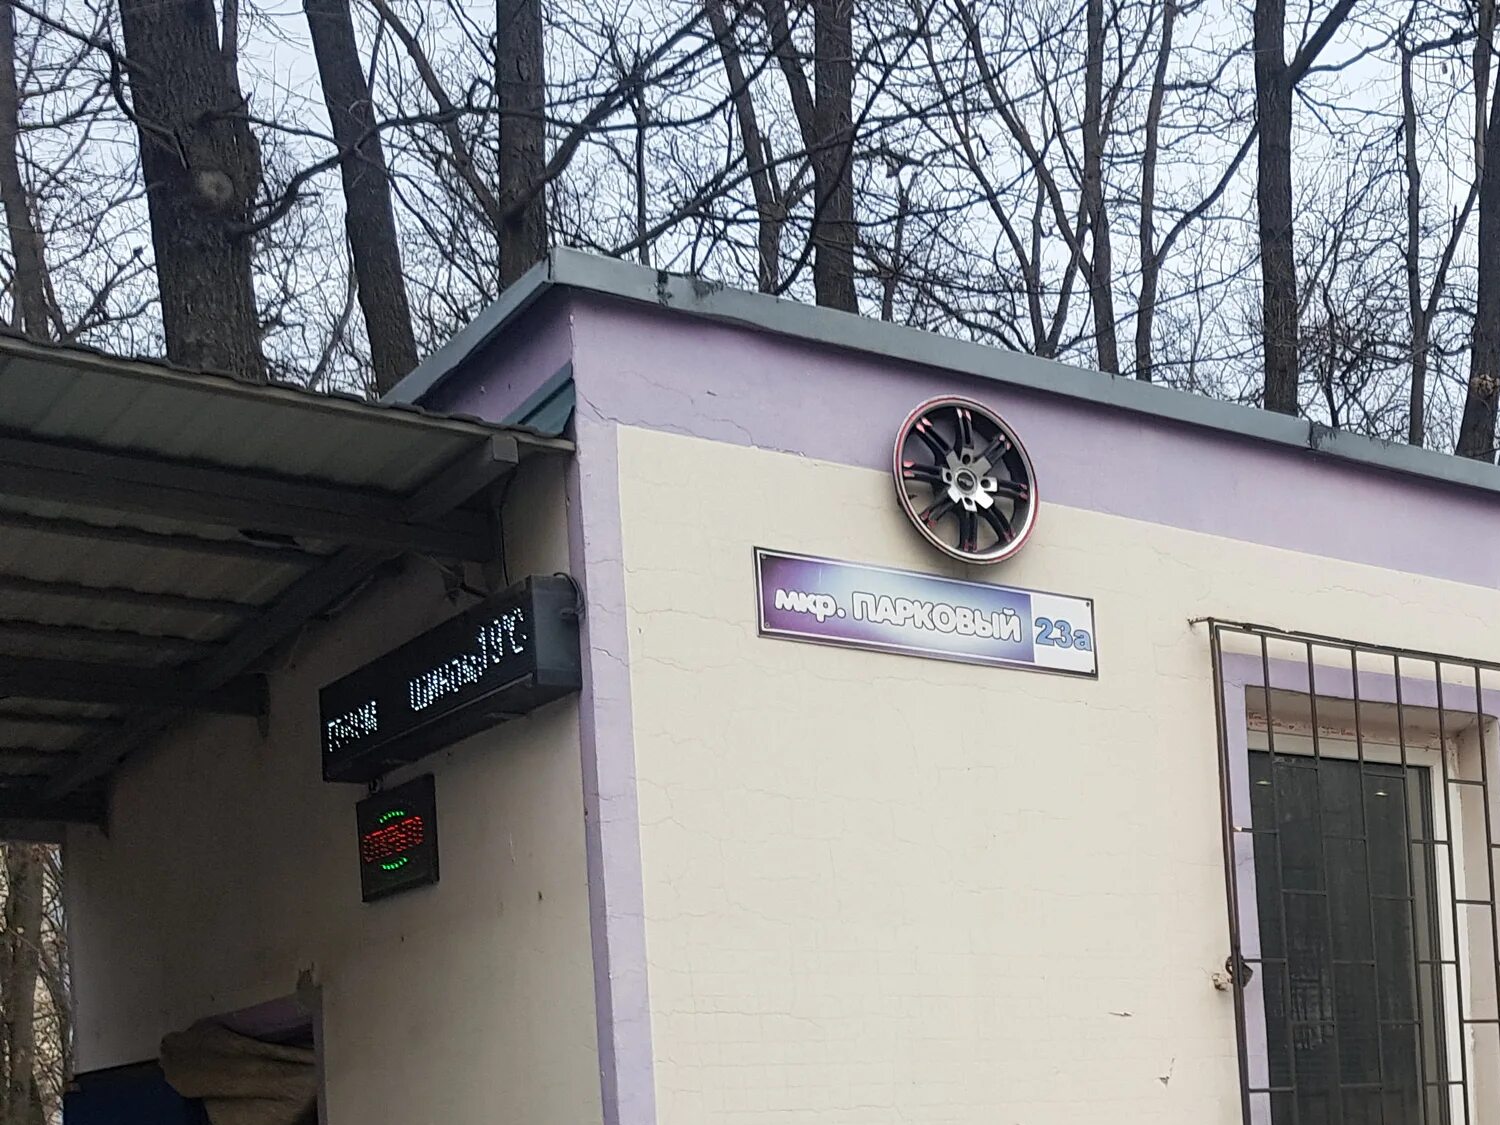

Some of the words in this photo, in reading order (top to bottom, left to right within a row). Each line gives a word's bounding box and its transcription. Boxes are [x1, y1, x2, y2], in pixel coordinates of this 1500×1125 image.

[774, 588, 846, 623] мкр.
[851, 591, 1022, 643] ПАРКОВЫЙ
[1034, 617, 1092, 651] 23а
